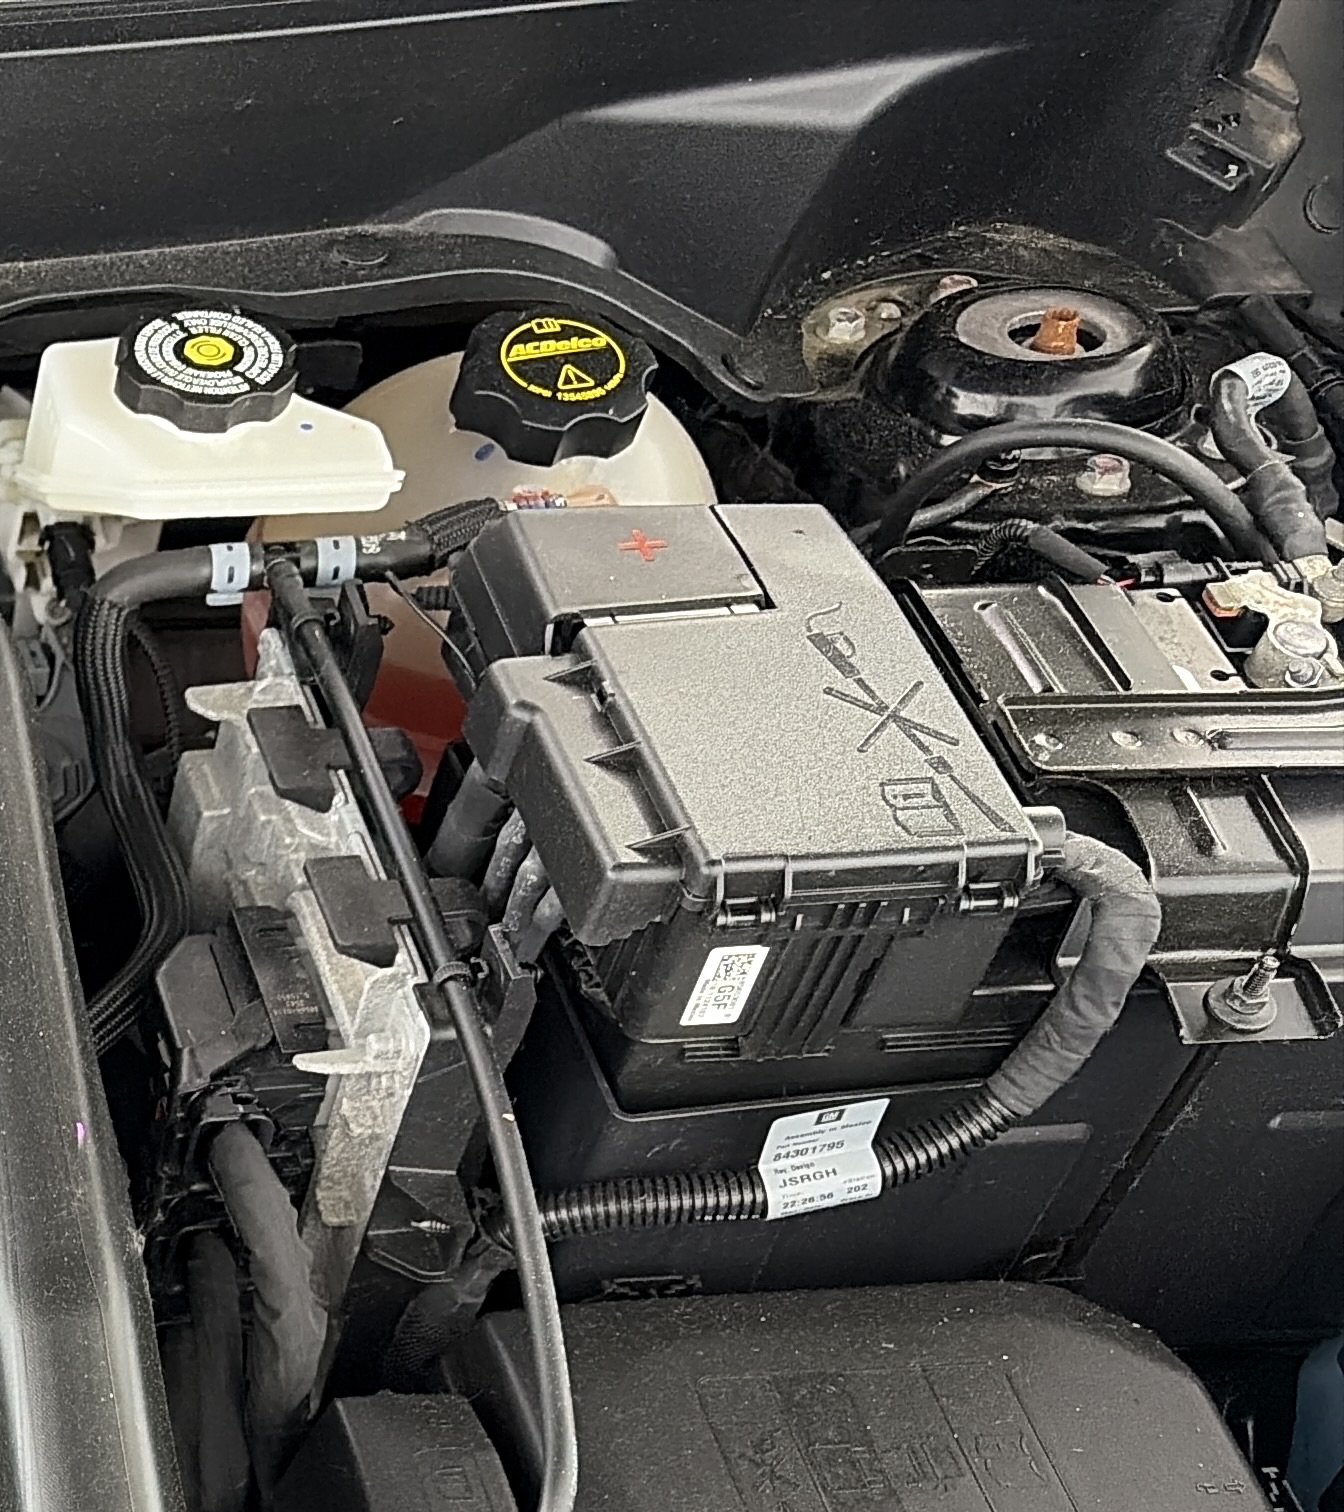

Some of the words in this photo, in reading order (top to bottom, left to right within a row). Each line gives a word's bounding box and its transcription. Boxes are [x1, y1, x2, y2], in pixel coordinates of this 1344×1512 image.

[509, 336, 607, 358] ACDelco
[712, 985, 735, 1010] G5F
[773, 1140, 845, 1161] 84301795
[778, 1168, 838, 1189] JSRGH
[846, 1183, 869, 1194] 202
